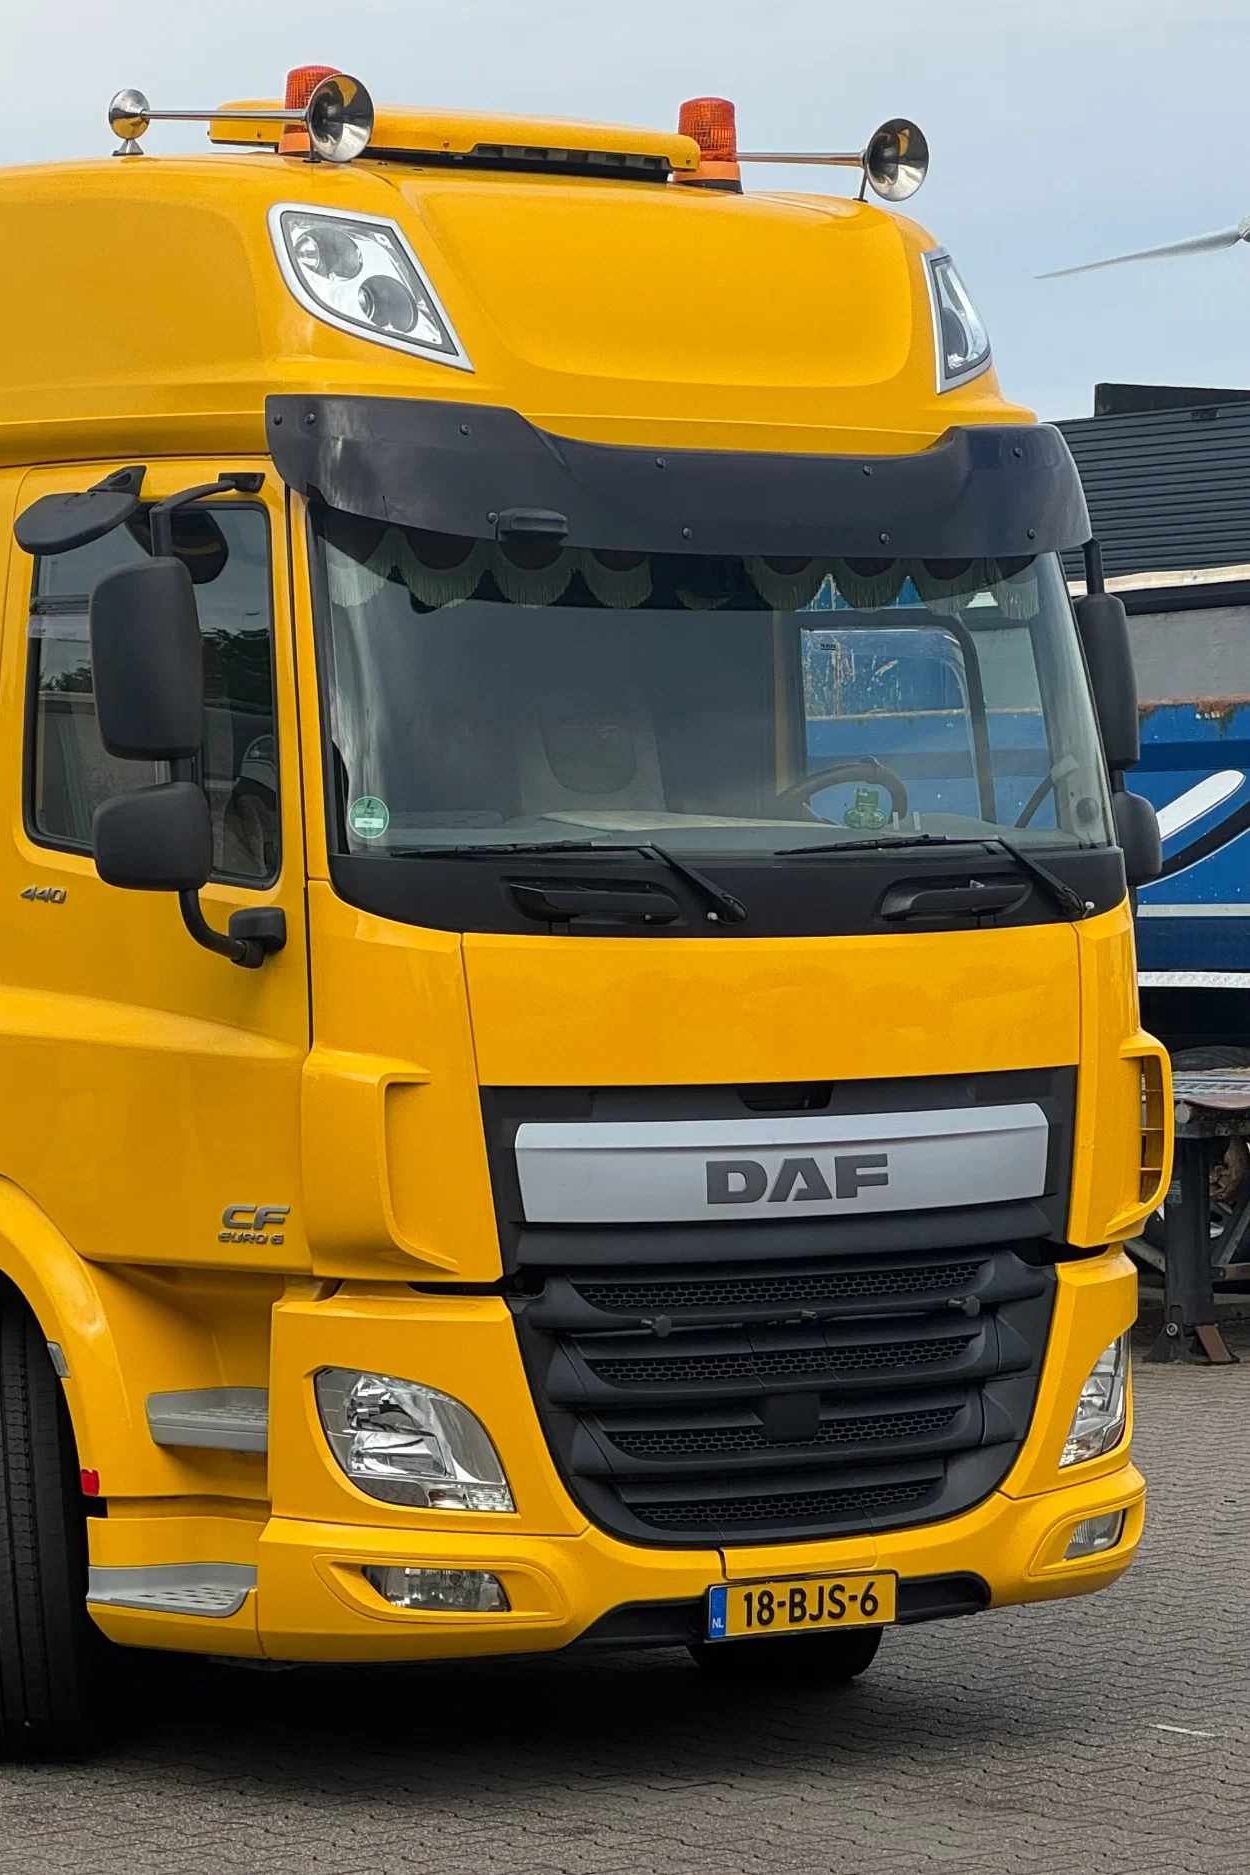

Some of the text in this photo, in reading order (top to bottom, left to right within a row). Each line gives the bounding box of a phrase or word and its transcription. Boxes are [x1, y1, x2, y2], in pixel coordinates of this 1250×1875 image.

[20, 885, 67, 904] 440
[706, 1153, 889, 1204] DAF
[222, 1204, 290, 1230] CF
[218, 1231, 284, 1245] EURO 6
[743, 1581, 879, 1627] 18-BJS-6
[711, 1617, 724, 1629] NL
